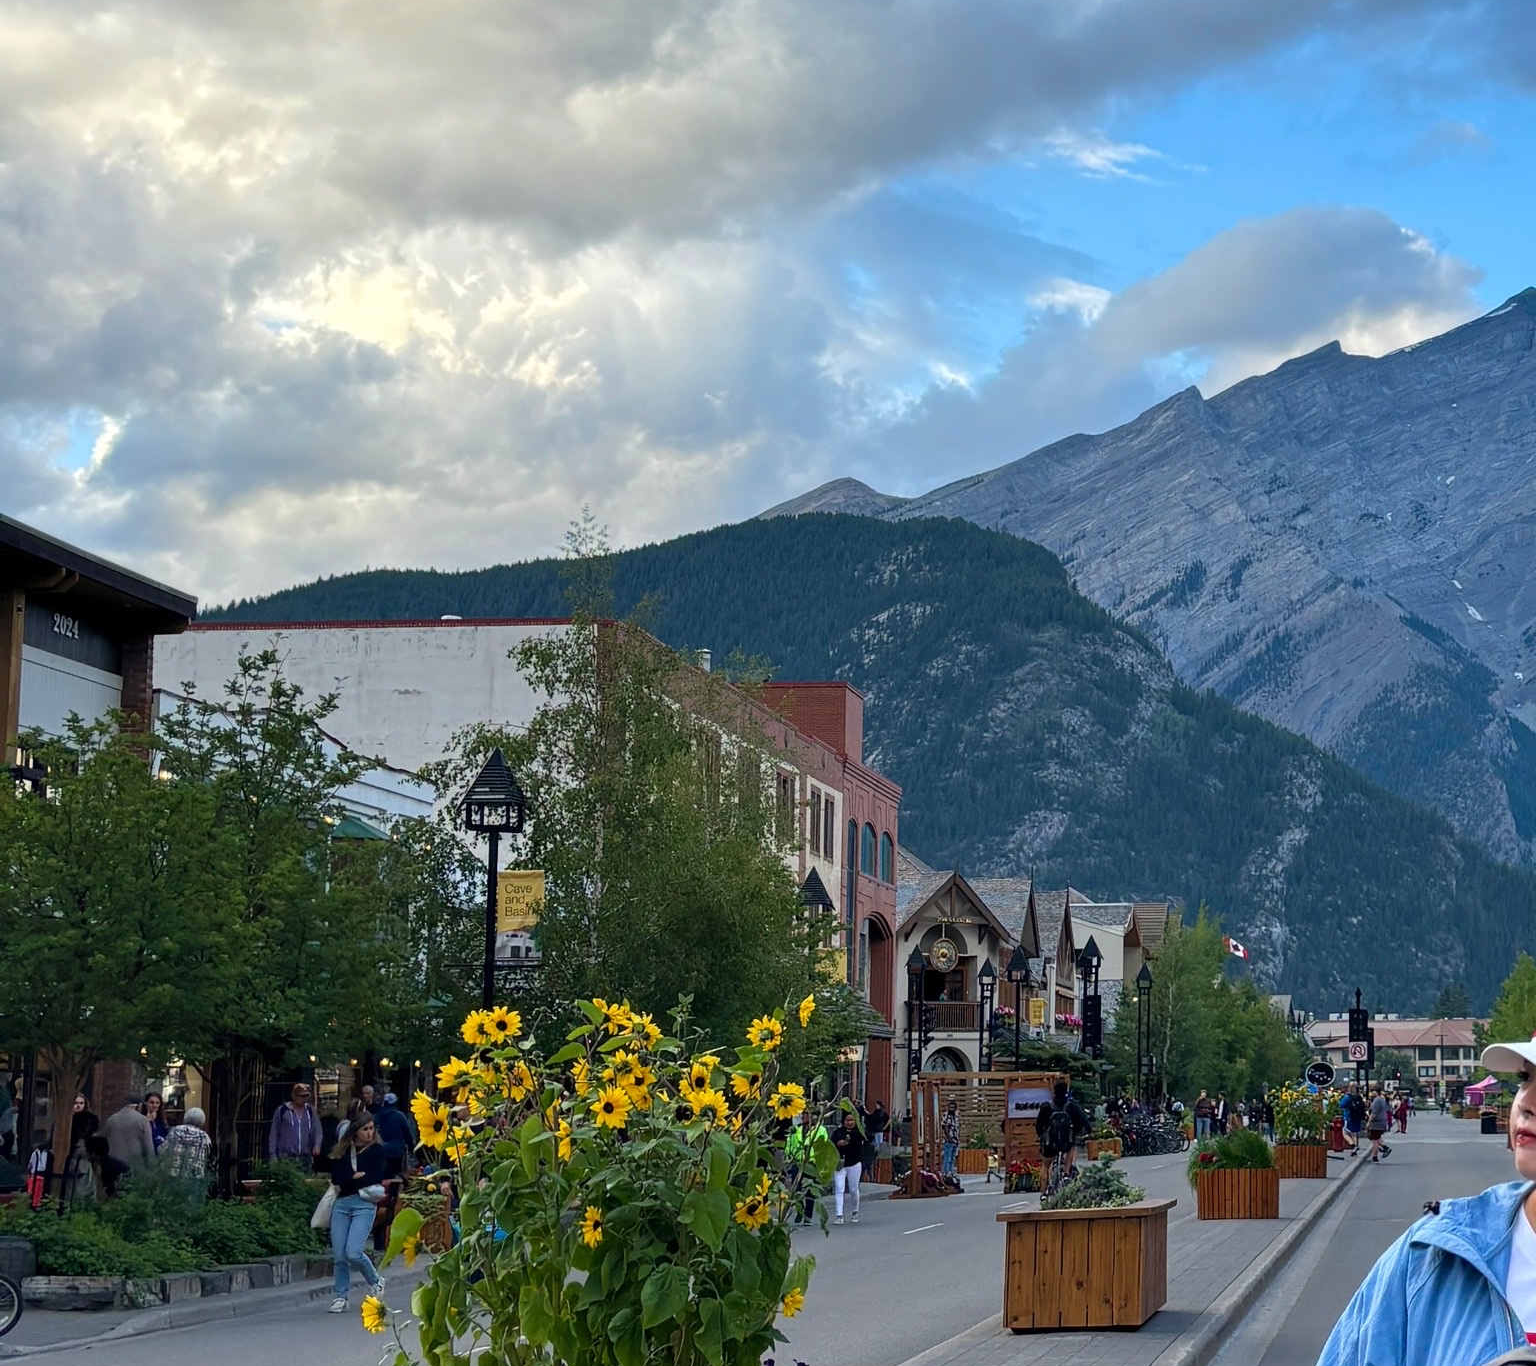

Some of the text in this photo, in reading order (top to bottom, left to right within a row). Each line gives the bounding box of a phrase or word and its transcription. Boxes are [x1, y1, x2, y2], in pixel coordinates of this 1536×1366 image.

[53, 612, 79, 639] 2024
[504, 883, 533, 894] Cave
[504, 895, 525, 905] and
